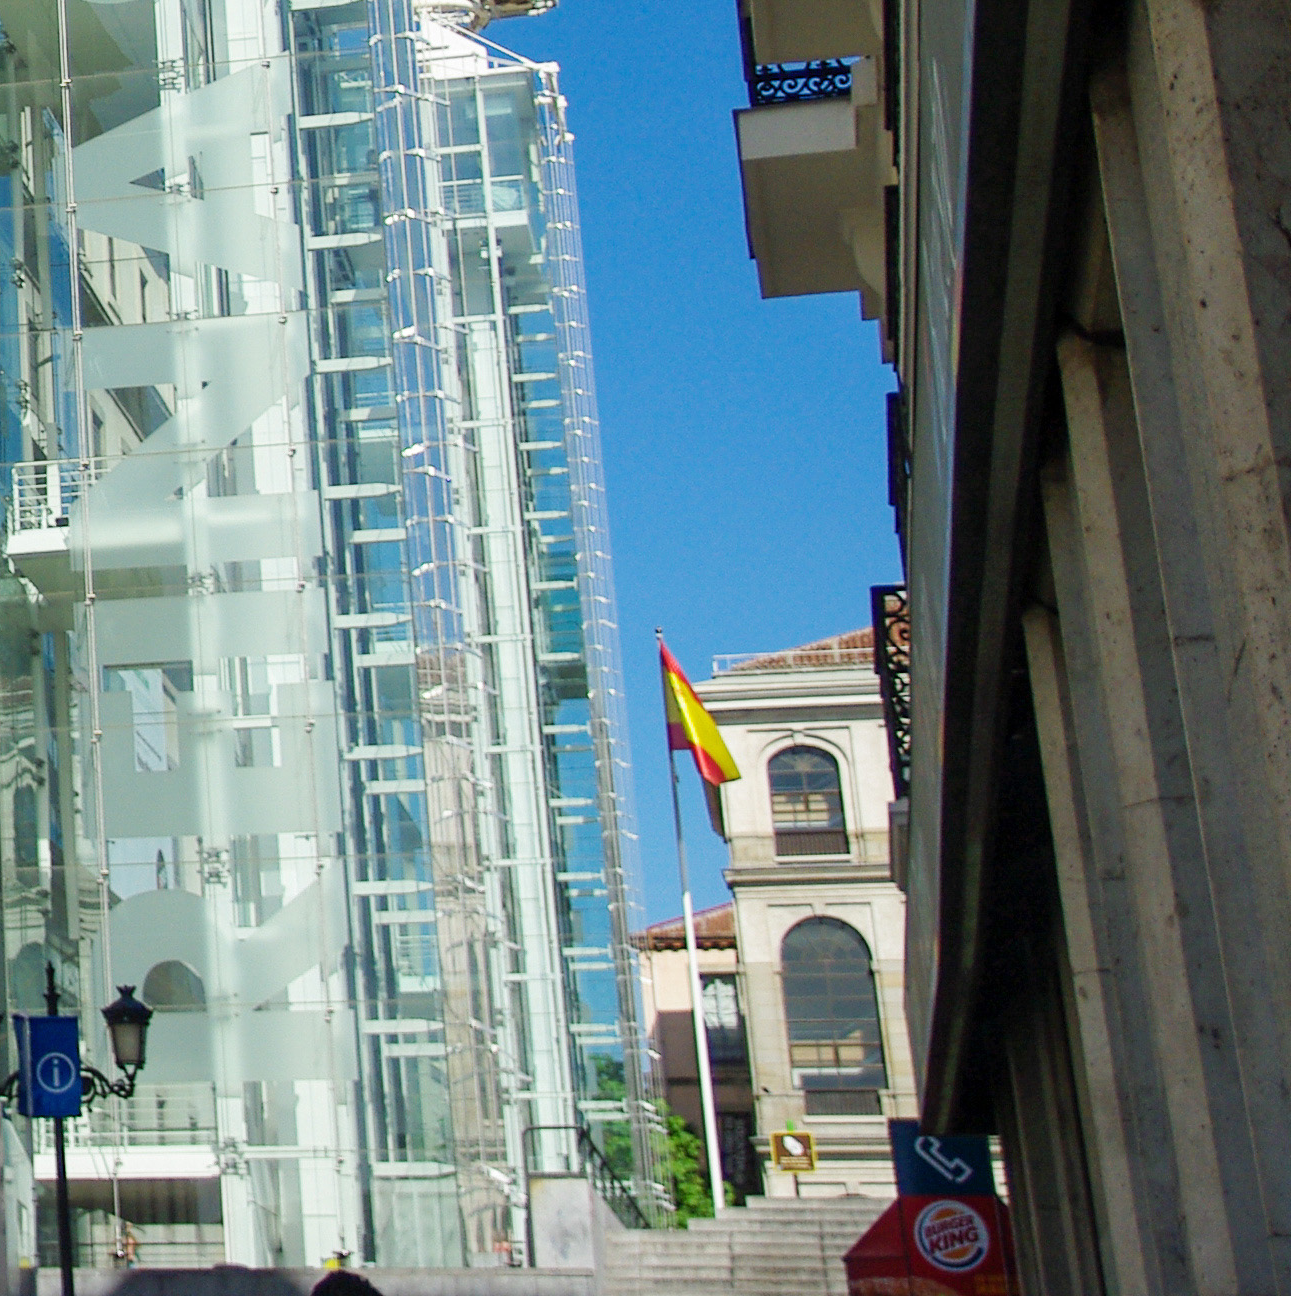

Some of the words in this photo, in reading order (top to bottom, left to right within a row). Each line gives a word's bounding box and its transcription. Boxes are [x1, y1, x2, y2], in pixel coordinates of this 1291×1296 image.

[69, 53, 357, 1084] REINA
[924, 1213, 974, 1238] BURGER
[929, 1226, 980, 1256] KING
